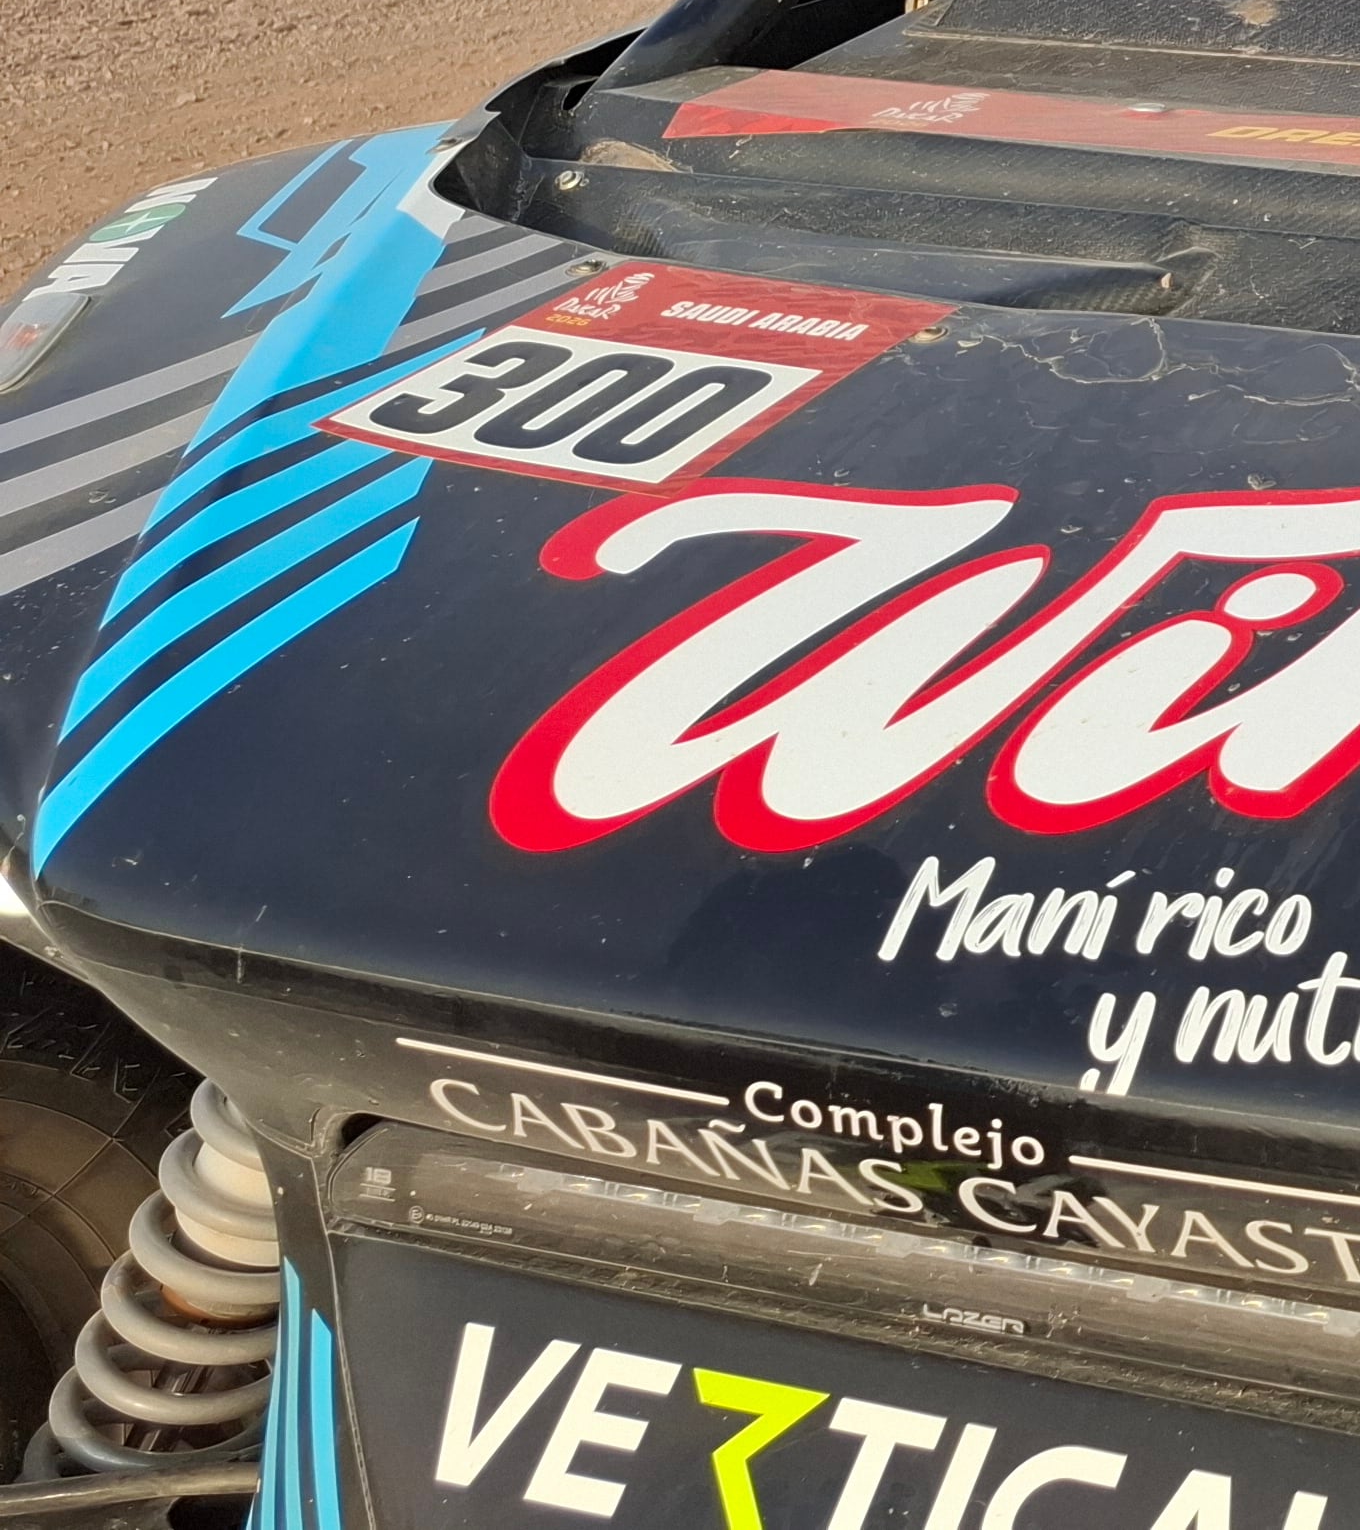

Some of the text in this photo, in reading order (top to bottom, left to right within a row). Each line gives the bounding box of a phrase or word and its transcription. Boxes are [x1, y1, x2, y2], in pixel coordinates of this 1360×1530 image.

[545, 313, 593, 327] 2026
[552, 296, 622, 321] DAKAR
[660, 299, 870, 342] SAUDI ARABIA
[368, 340, 774, 465] 300
[877, 855, 1314, 964] Maní rico
[1078, 987, 1157, 1096] y
[428, 1077, 925, 1215] CABAÑAS
[744, 1080, 1046, 1170] Complejo
[921, 1303, 1027, 1335] LAZER
